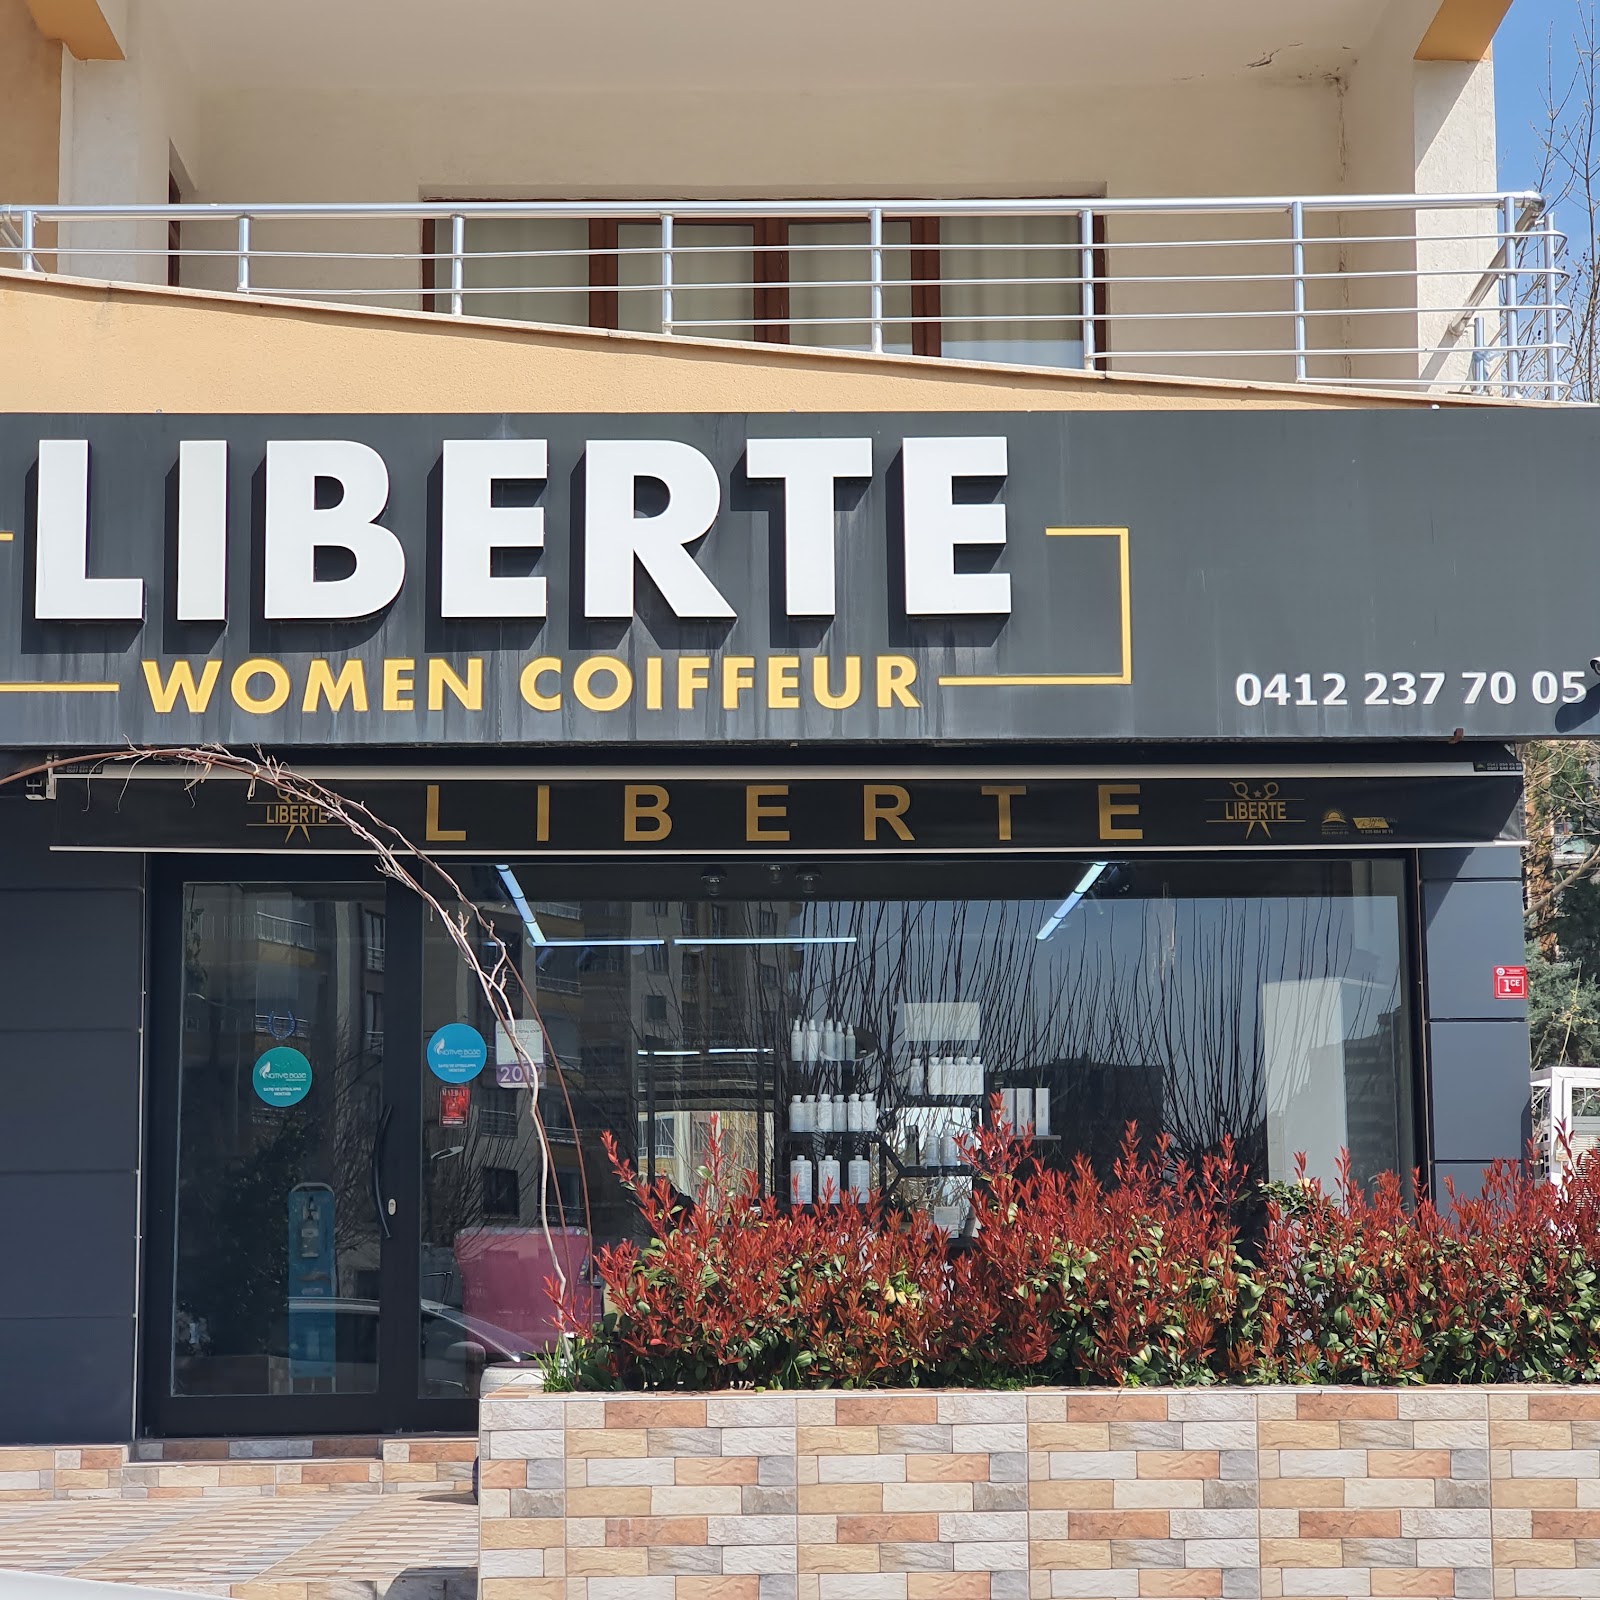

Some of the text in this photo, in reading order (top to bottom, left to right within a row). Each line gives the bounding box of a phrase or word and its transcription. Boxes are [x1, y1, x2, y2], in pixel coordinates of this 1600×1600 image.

[35, 437, 1012, 621] LIBERTE
[142, 656, 919, 713] WOMEN COIFFEUR
[1235, 670, 1587, 706] 0412 237 70 05
[266, 805, 328, 824] LIBERTE
[425, 784, 1144, 842] LIBERTE
[1225, 801, 1287, 820] LIBERTE
